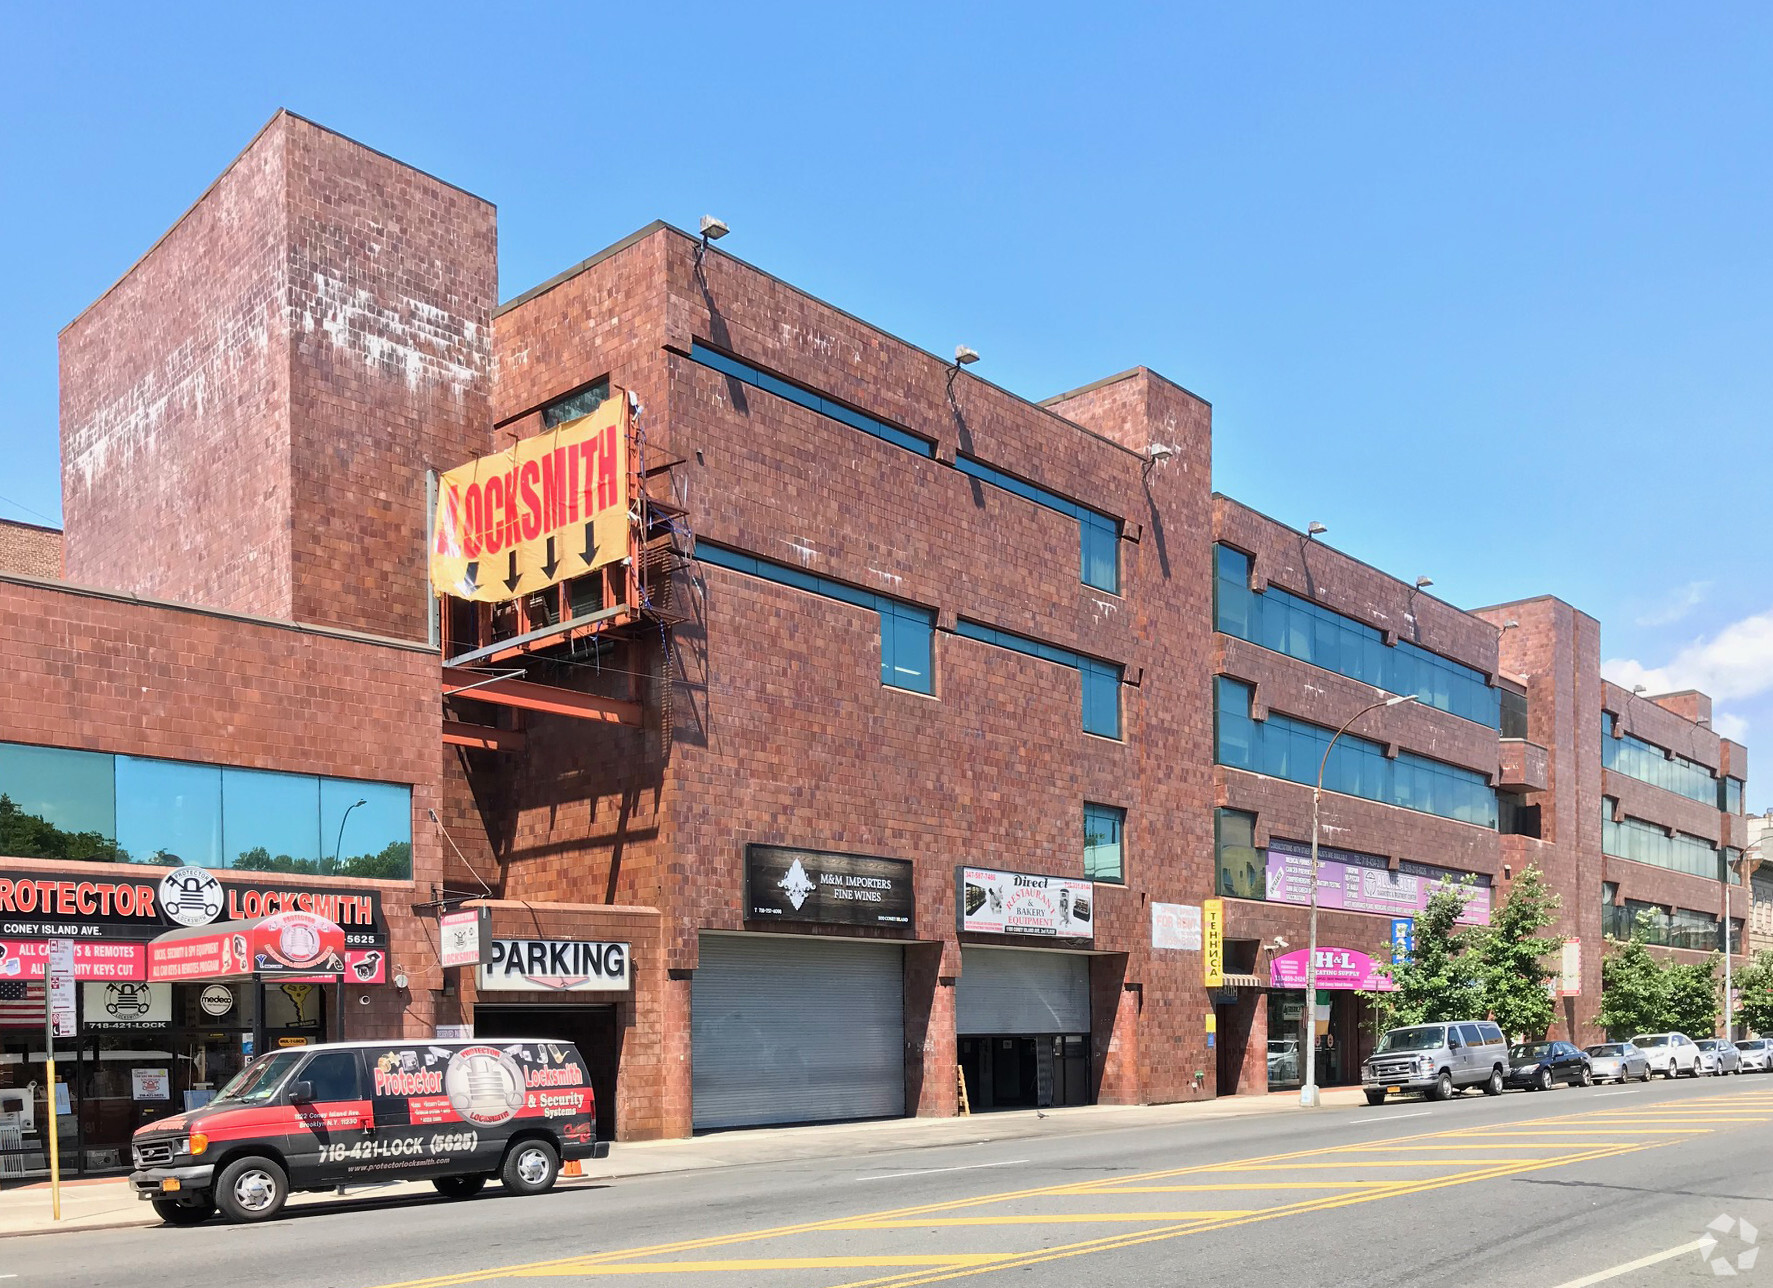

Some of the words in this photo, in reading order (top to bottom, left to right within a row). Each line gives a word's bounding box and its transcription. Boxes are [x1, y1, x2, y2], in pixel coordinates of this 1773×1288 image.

[174, 869, 210, 882] PROTECTOR
[820, 873, 843, 886] M&M
[846, 876, 892, 890] IMPORTERS
[1014, 874, 1048, 889] Direct
[834, 888, 852, 899] FINE
[854, 891, 882, 903] WINES
[1005, 887, 1055, 915] RESTAURANT
[1027, 898, 1034, 907] &
[228, 889, 373, 925] LOCKSMITH
[1016, 906, 1046, 917] BAKERY
[1008, 916, 1053, 927] EQUIPMENT
[4, 923, 39, 934] CONEY
[41, 925, 79, 935] ISLAND
[81, 926, 103, 936] AVE.
[19, 944, 36, 956] ALL
[84, 947, 91, 956] &
[94, 946, 135, 958] REMOTES
[486, 941, 625, 977] PARKING
[1315, 952, 1355, 969] H&L
[94, 964, 115, 976] KEYS
[117, 964, 134, 976] CUT
[202, 995, 232, 1004] medeco
[374, 1066, 443, 1096] Protector
[523, 1063, 583, 1087] Locksmith
[528, 1095, 536, 1108] &
[540, 1093, 584, 1109] Security
[544, 1108, 577, 1118] Systems
[318, 1137, 423, 1163] 718-421-LOCK
[429, 1130, 478, 1155] (5625)
[347, 1157, 451, 1173] www.protectorlocksmith.com
